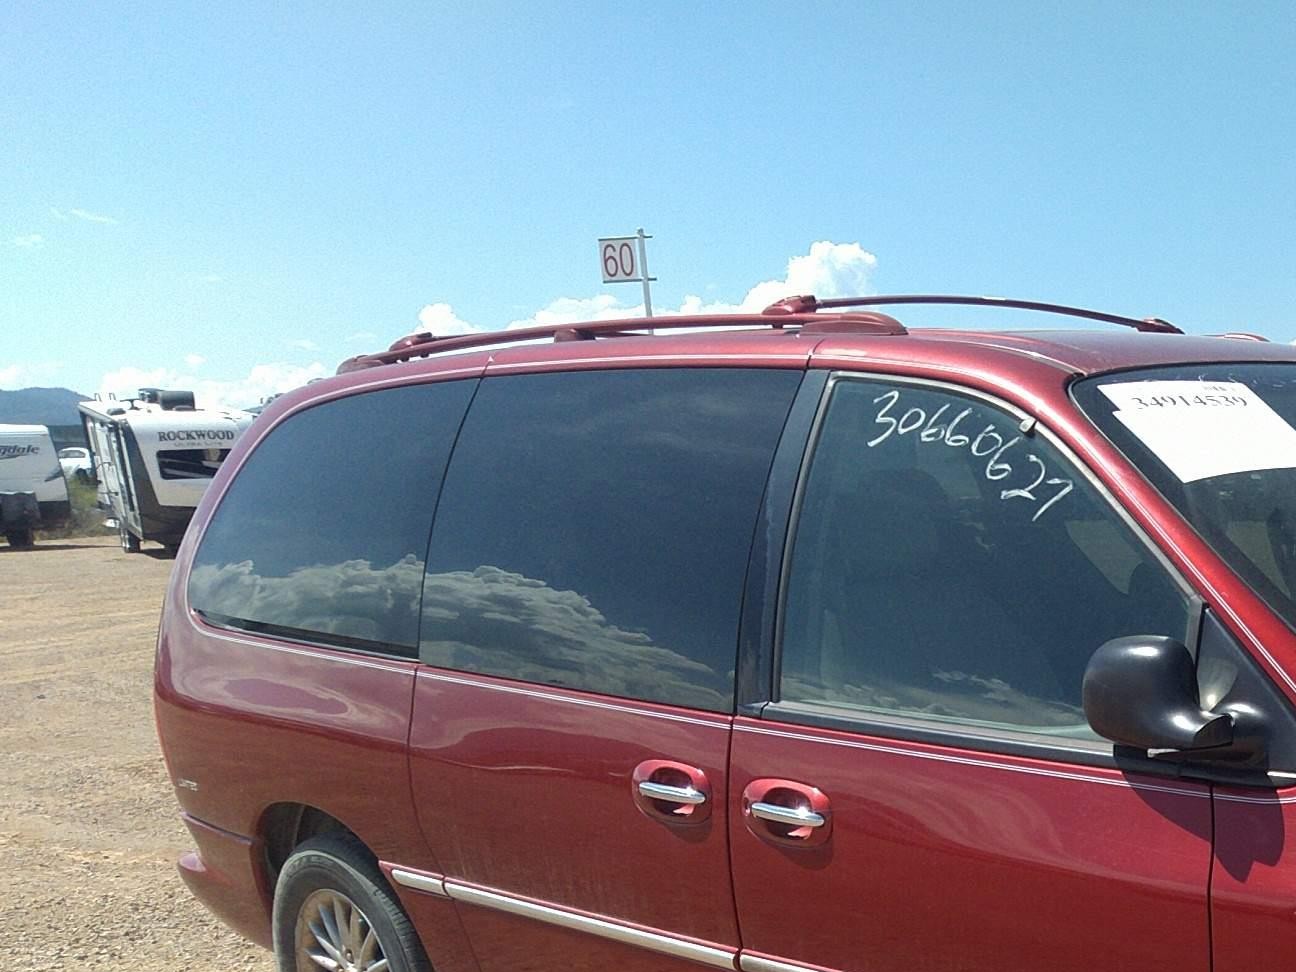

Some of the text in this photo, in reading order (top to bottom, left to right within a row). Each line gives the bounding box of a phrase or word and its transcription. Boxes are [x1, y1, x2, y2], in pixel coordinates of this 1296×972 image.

[603, 242, 634, 278] 60
[157, 430, 235, 442] ROCKWOOD
[867, 390, 1074, 522] 30660627
